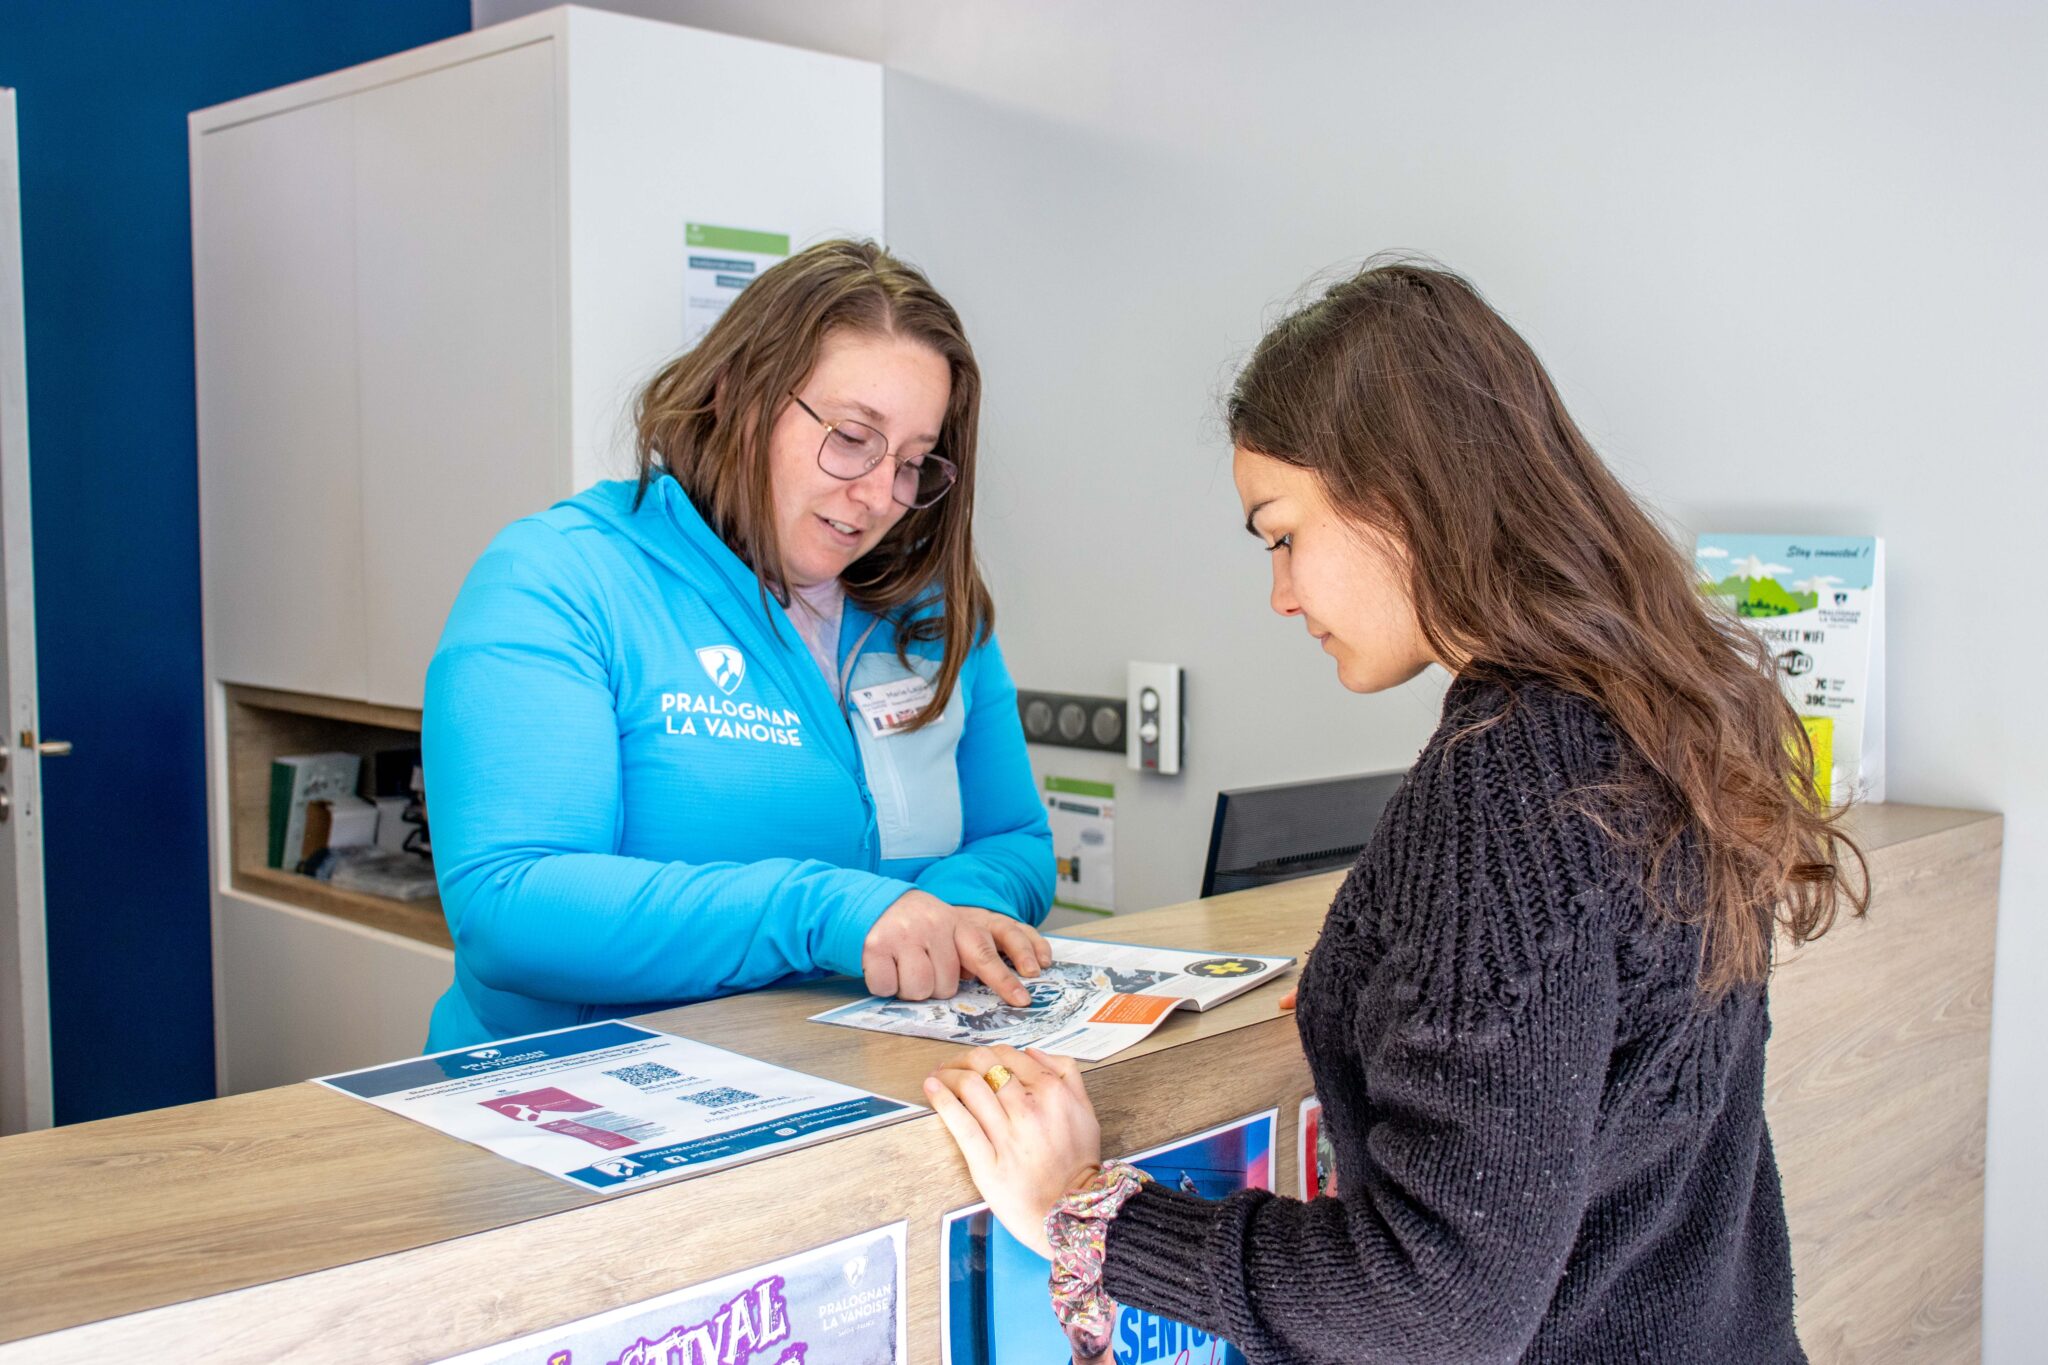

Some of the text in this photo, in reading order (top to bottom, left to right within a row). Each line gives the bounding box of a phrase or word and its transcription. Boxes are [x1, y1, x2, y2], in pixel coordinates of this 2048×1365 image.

[1786, 545, 1811, 560] Stay
[1803, 630, 1824, 643] WIFI
[661, 693, 801, 727] PRALOGNAN
[666, 715, 802, 747] LA VANOISE
[819, 1283, 892, 1318] PRALOGNAN
[823, 1298, 889, 1331] LA VANOISE
